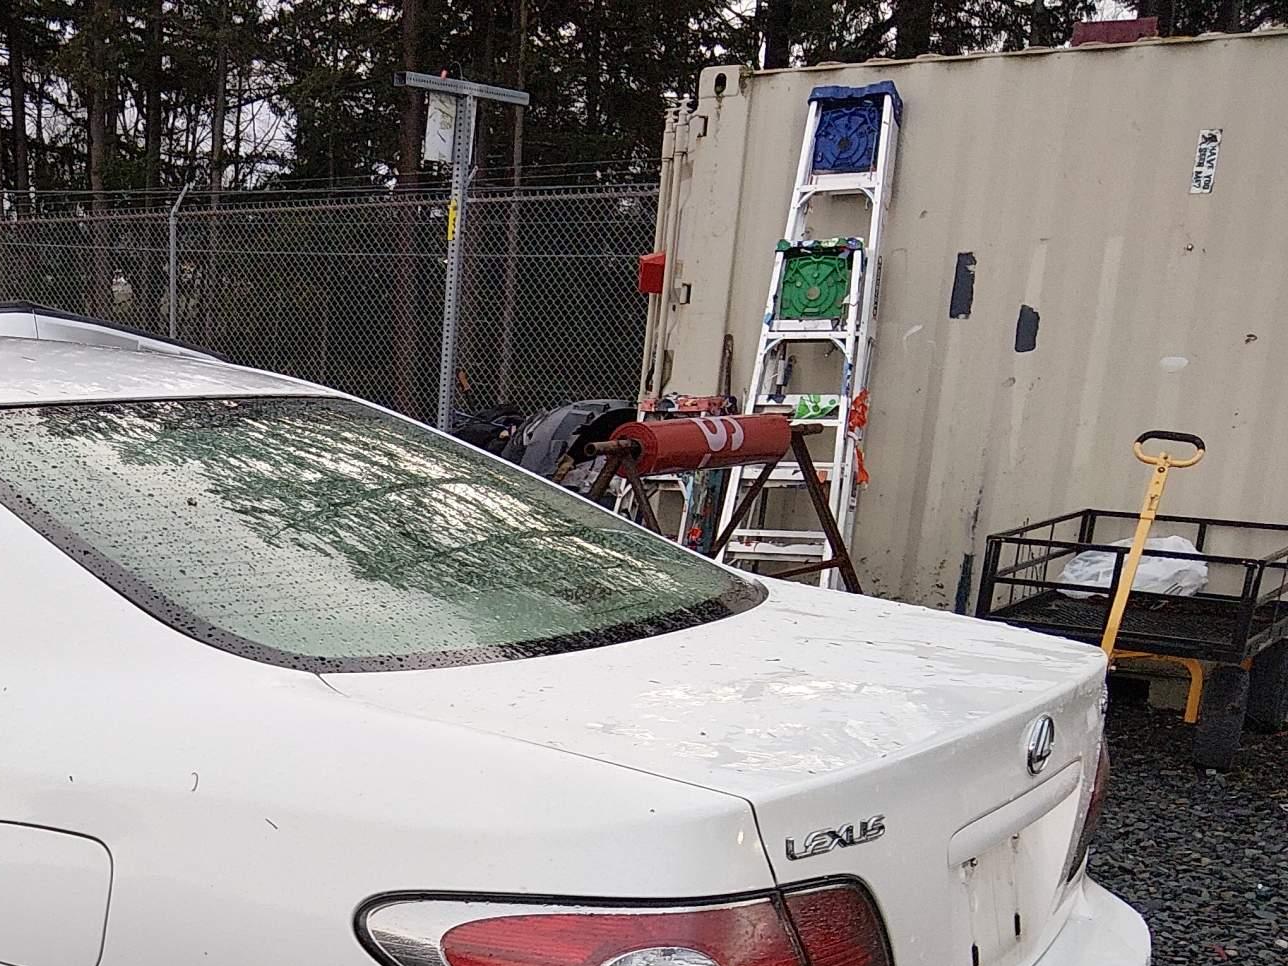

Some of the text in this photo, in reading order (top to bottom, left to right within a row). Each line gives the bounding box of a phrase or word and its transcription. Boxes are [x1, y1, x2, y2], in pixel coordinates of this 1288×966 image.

[1202, 145, 1217, 190] HAVE YOU
[785, 814, 886, 862] LEXUS
